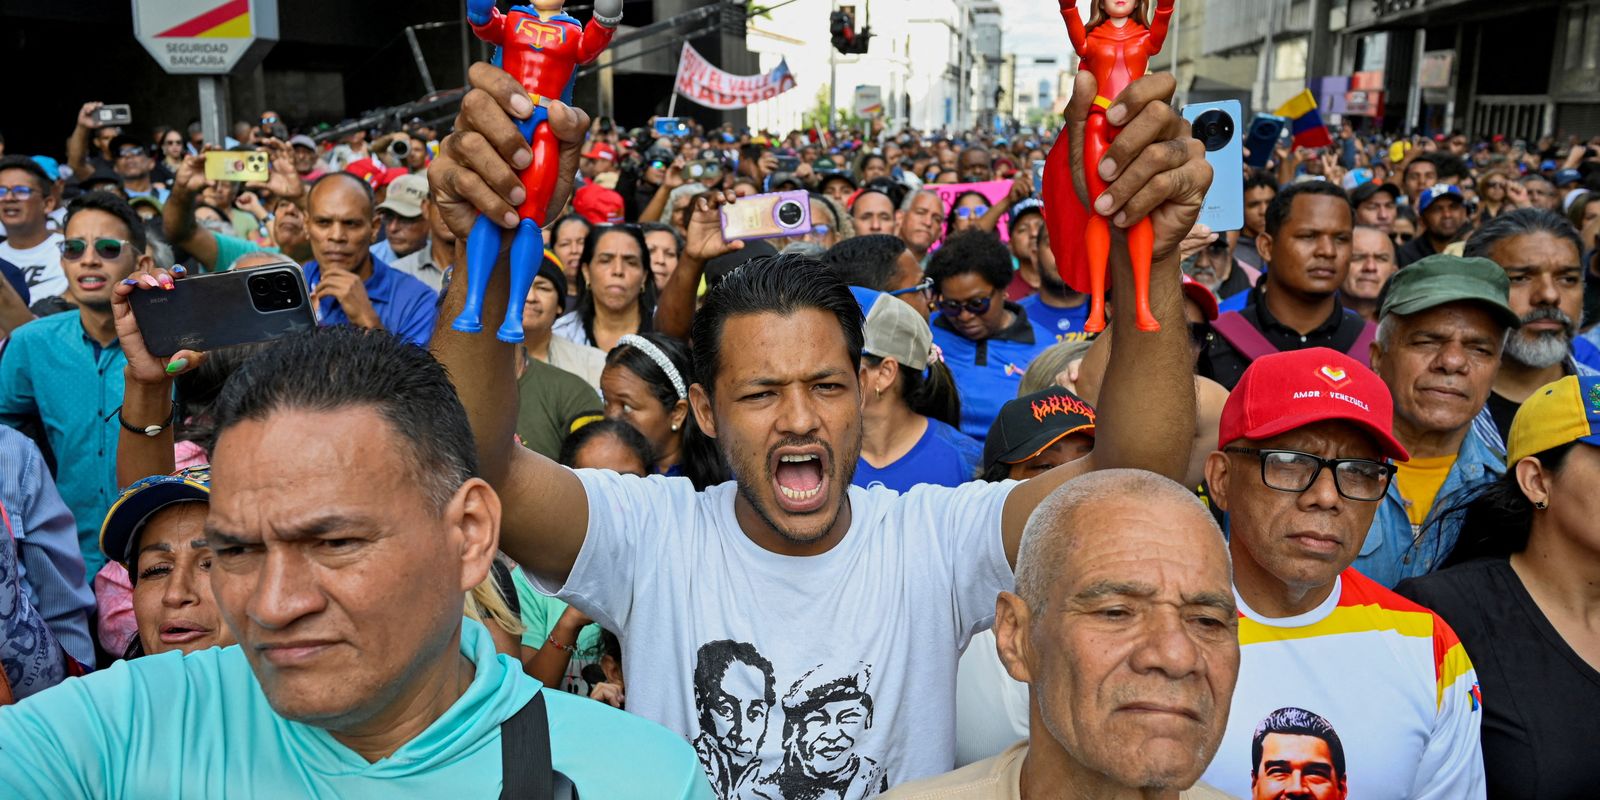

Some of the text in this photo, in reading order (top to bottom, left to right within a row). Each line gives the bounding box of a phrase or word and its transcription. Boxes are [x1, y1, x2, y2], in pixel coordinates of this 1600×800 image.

[166, 43, 228, 53] SEGURIDAD
[170, 55, 225, 65] BANCARIA
[1293, 390, 1320, 399] AMOR
[1329, 391, 1370, 412] VENEZUELA
